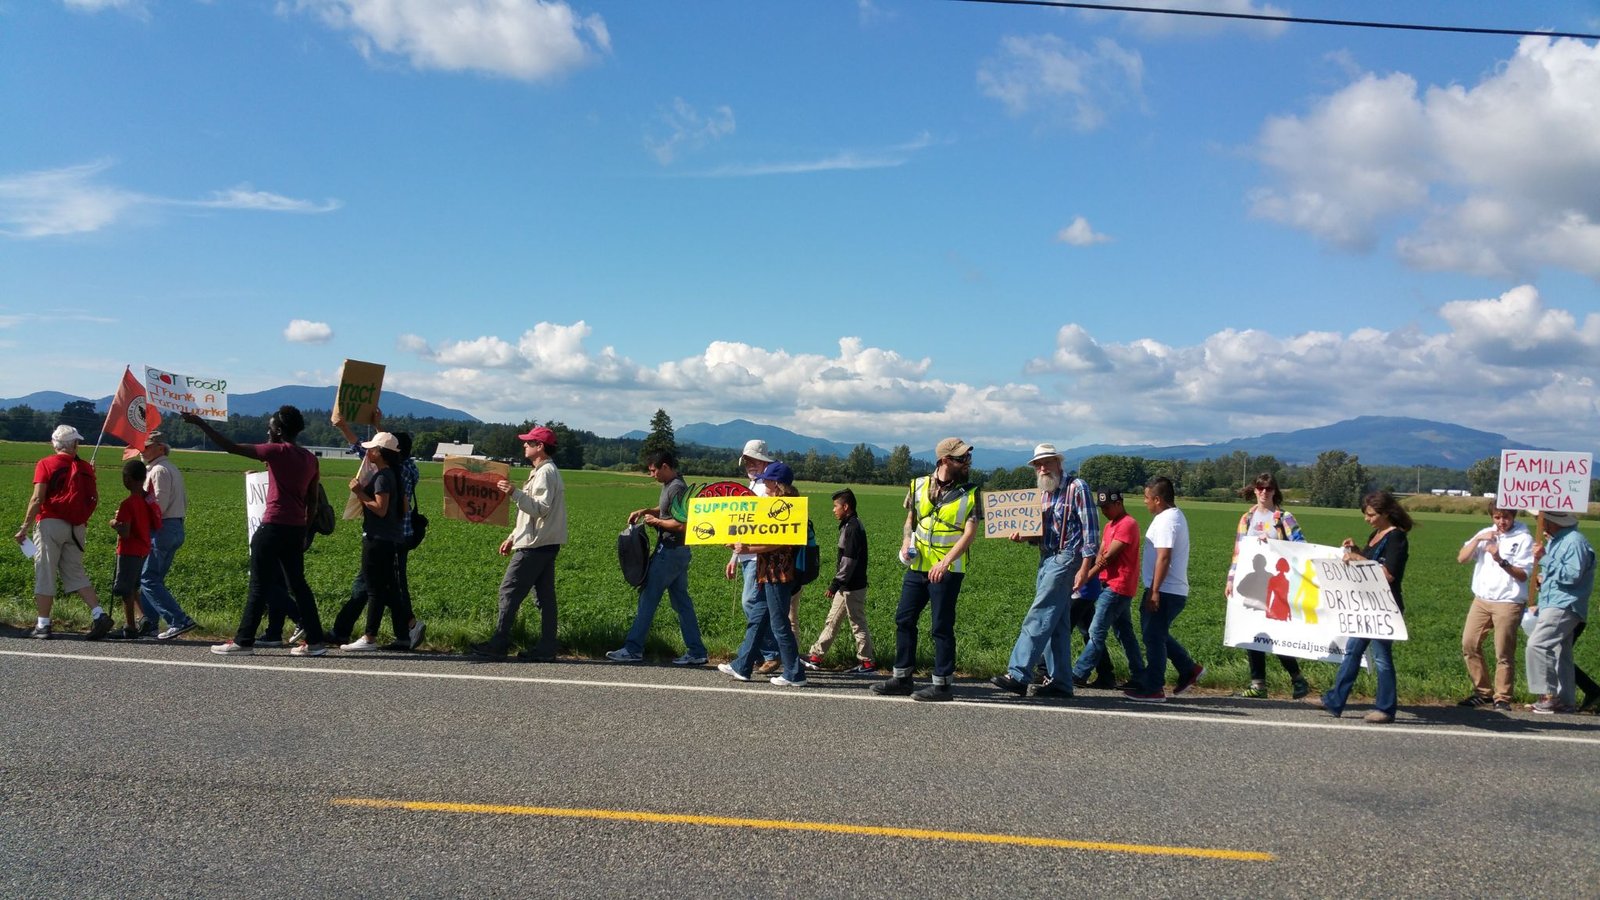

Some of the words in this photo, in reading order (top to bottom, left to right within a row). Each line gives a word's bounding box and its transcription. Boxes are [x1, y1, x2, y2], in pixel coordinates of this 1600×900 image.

[149, 381, 196, 402] Thank
[205, 394, 214, 402] A
[186, 376, 228, 394] Food?
[1505, 453, 1588, 475] FAMILIAS
[453, 474, 499, 500] Union
[1503, 477, 1562, 495] UNIDAS
[694, 501, 758, 513] SUPPORT
[987, 491, 1036, 508] BOYCOTT
[1500, 493, 1574, 510] JUSTICIA
[728, 513, 755, 522] THE
[728, 523, 801, 536] BOYCOTT
[987, 520, 1042, 535] BERRIES!
[1339, 612, 1394, 636] BERRIES
